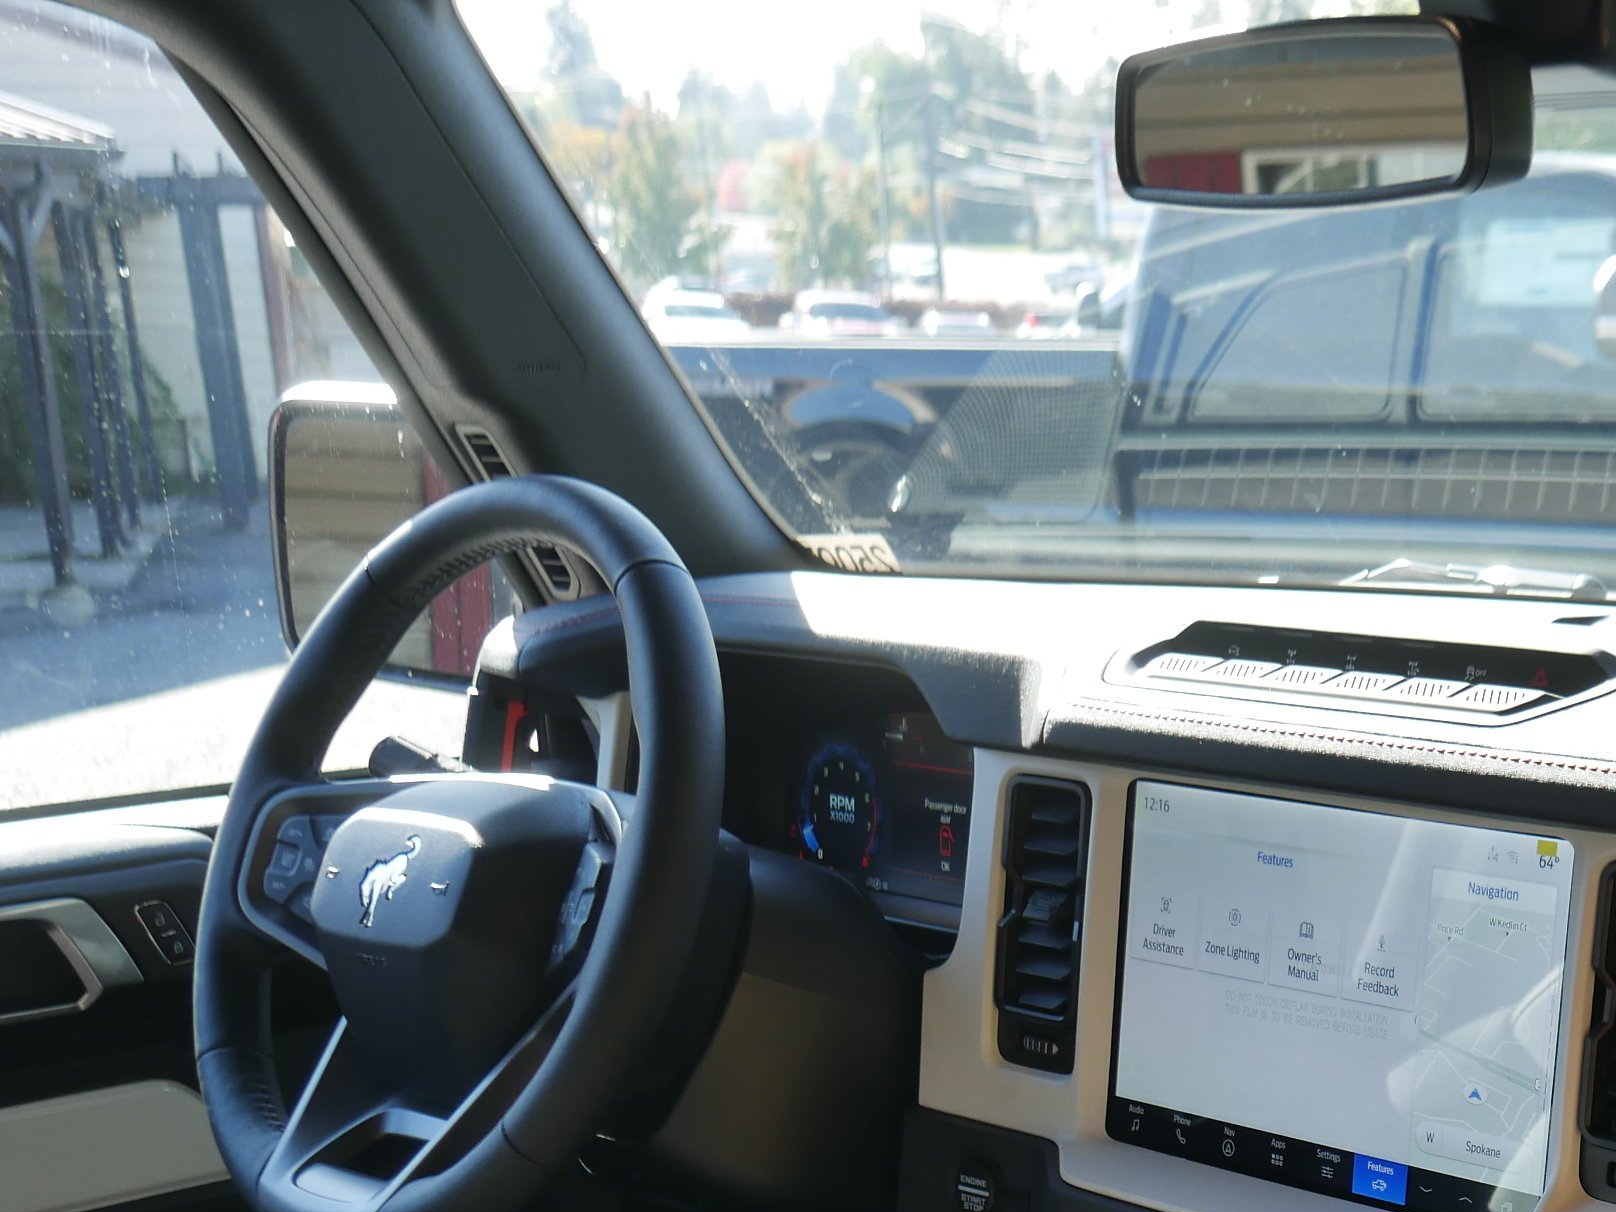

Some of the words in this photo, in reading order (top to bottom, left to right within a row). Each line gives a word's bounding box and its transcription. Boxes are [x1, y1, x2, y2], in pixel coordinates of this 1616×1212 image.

[829, 793, 855, 812] RPM
[1144, 797, 1170, 813] 12:16
[830, 810, 855, 824] X1000
[941, 861, 950, 872] OK
[1257, 851, 1294, 868] Features
[1467, 881, 1519, 901] Navigation
[1153, 923, 1176, 938] Driver
[1489, 918, 1496, 927] W
[1142, 938, 1184, 957] Assistance
[1205, 941, 1226, 956] Zone
[1226, 944, 1260, 965] Lighting
[1287, 948, 1322, 965] Owner's
[1287, 965, 1319, 982] Manual
[1364, 961, 1395, 979] Record
[1357, 978, 1399, 997] Feedback
[1225, 989, 1235, 1001] DO
[1238, 991, 1252, 1003] NOT
[1255, 994, 1278, 1008] TOUCH
[1280, 998, 1308, 1013] DISPLAY
[1311, 1002, 1337, 1017] DURING
[1340, 1006, 1389, 1026] INSTALLATION
[1225, 1003, 1240, 1016] THIS
[1243, 1006, 1258, 1018] FILM
[1271, 1010, 1281, 1022] TO
[1283, 1012, 1293, 1024] BE
[1295, 1014, 1329, 1031] REMOVED
[1332, 1020, 1361, 1036] BEFORE
[1128, 1103, 1145, 1115] Audio
[1173, 1114, 1192, 1126] Phone
[1224, 1126, 1236, 1137] Nav
[1271, 1137, 1286, 1150] Apps
[1426, 1131, 1435, 1143] W
[1465, 1140, 1501, 1159] Spokane
[1316, 1148, 1341, 1163] Settings
[1367, 1160, 1394, 1176] Features
[960, 1174, 988, 1188] ENGINE
[961, 1193, 986, 1206] START
[963, 1202, 984, 1212] STOP
